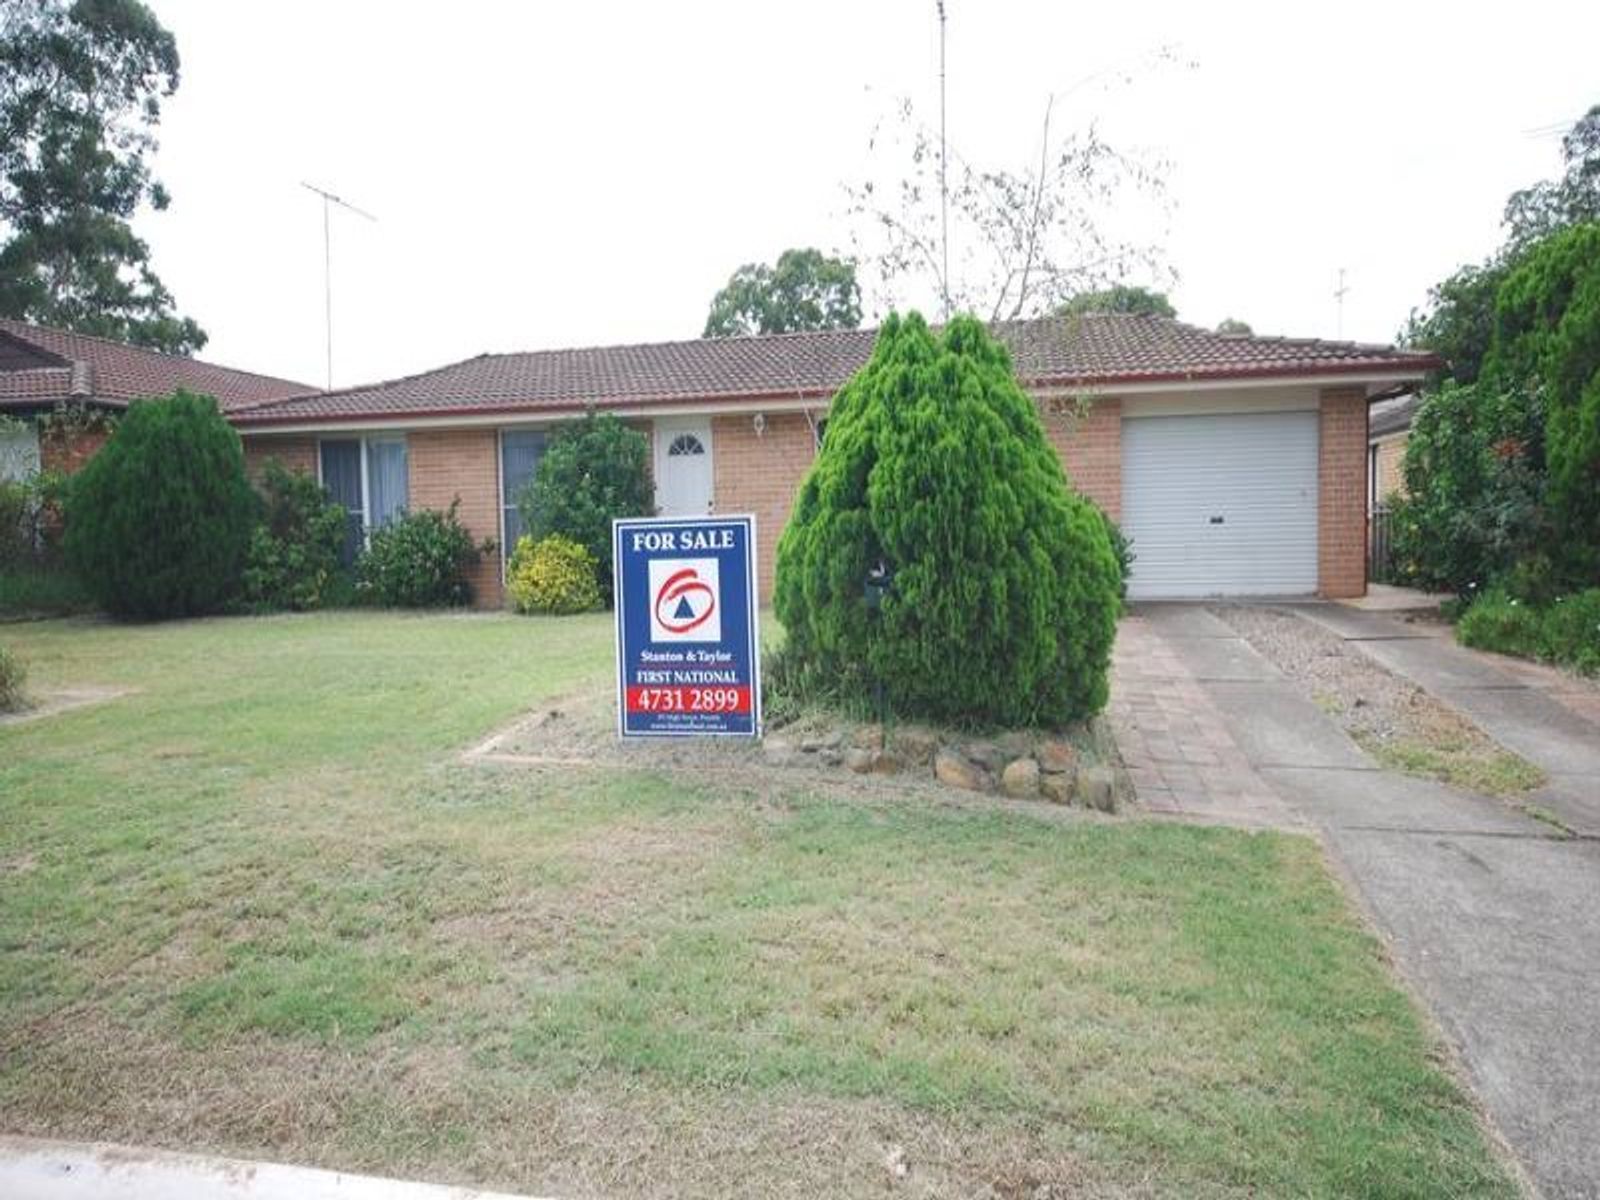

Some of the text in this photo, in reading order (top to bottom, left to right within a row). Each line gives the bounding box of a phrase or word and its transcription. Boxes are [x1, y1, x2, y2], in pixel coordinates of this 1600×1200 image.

[633, 530, 735, 551] FOR SALE
[640, 650, 731, 664] Stanton & Taylor
[638, 670, 737, 683] FIRST NATIONAL
[638, 689, 739, 711] 4731 2899
